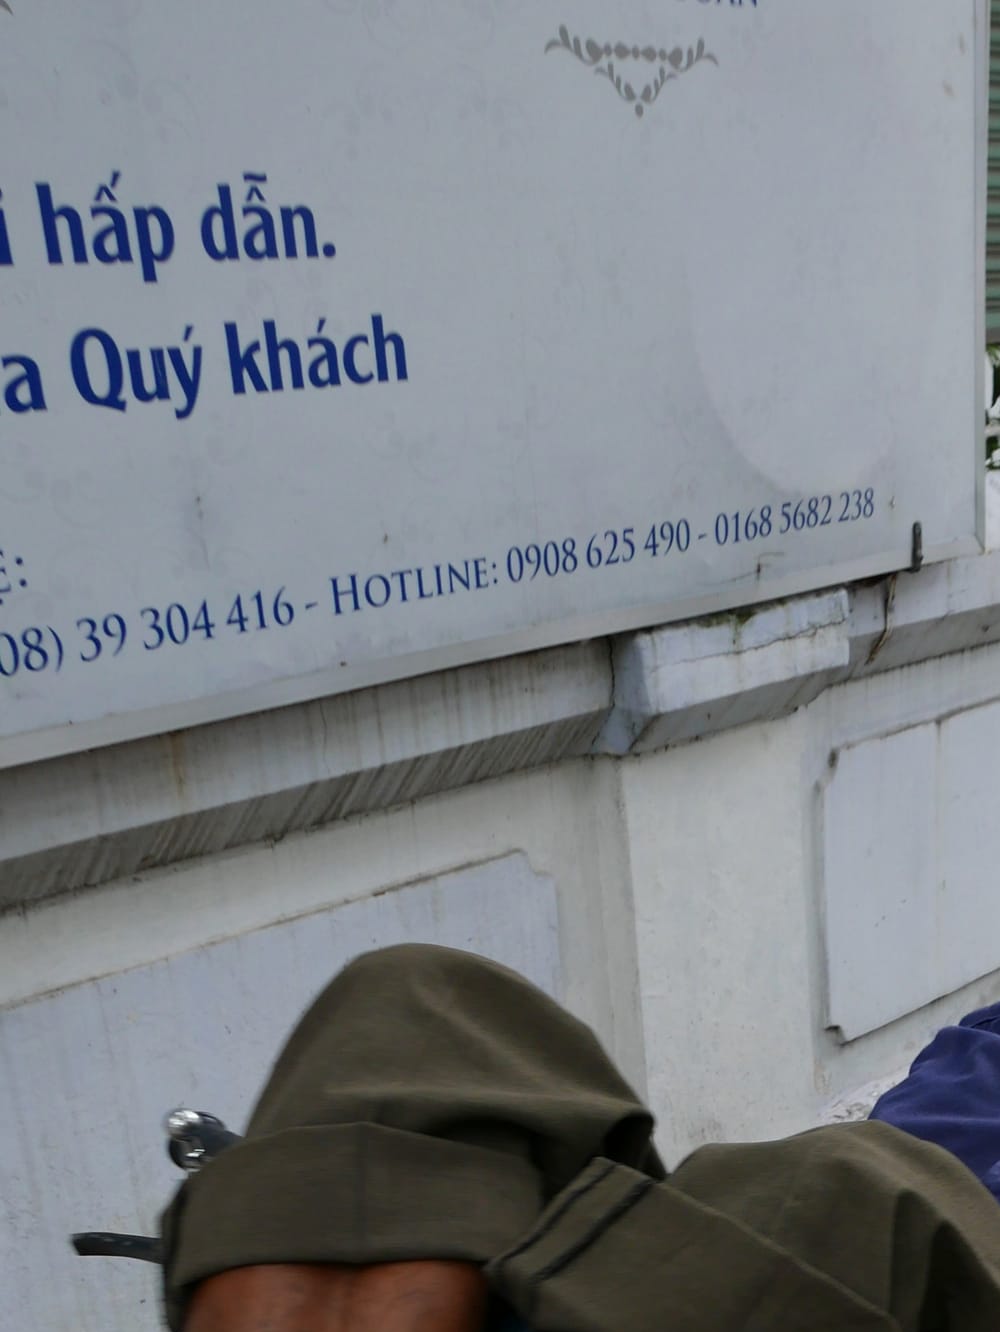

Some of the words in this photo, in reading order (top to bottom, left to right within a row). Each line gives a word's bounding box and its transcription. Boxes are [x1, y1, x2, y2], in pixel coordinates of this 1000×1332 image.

[34, 168, 175, 283] hấp
[200, 171, 337, 263] dẫn.
[69, 324, 203, 421] Quý
[223, 313, 409, 396] khách
[76, 612, 128, 663] 39
[140, 599, 216, 651] 304
[226, 586, 295, 633] 416
[328, 555, 500, 617] HOTLINE:
[506, 536, 579, 584] 0908
[586, 526, 637, 570] 625
[643, 517, 692, 558] 490
[714, 504, 773, 546] 0168
[779, 494, 833, 535] 5682
[837, 487, 876, 524] 238
